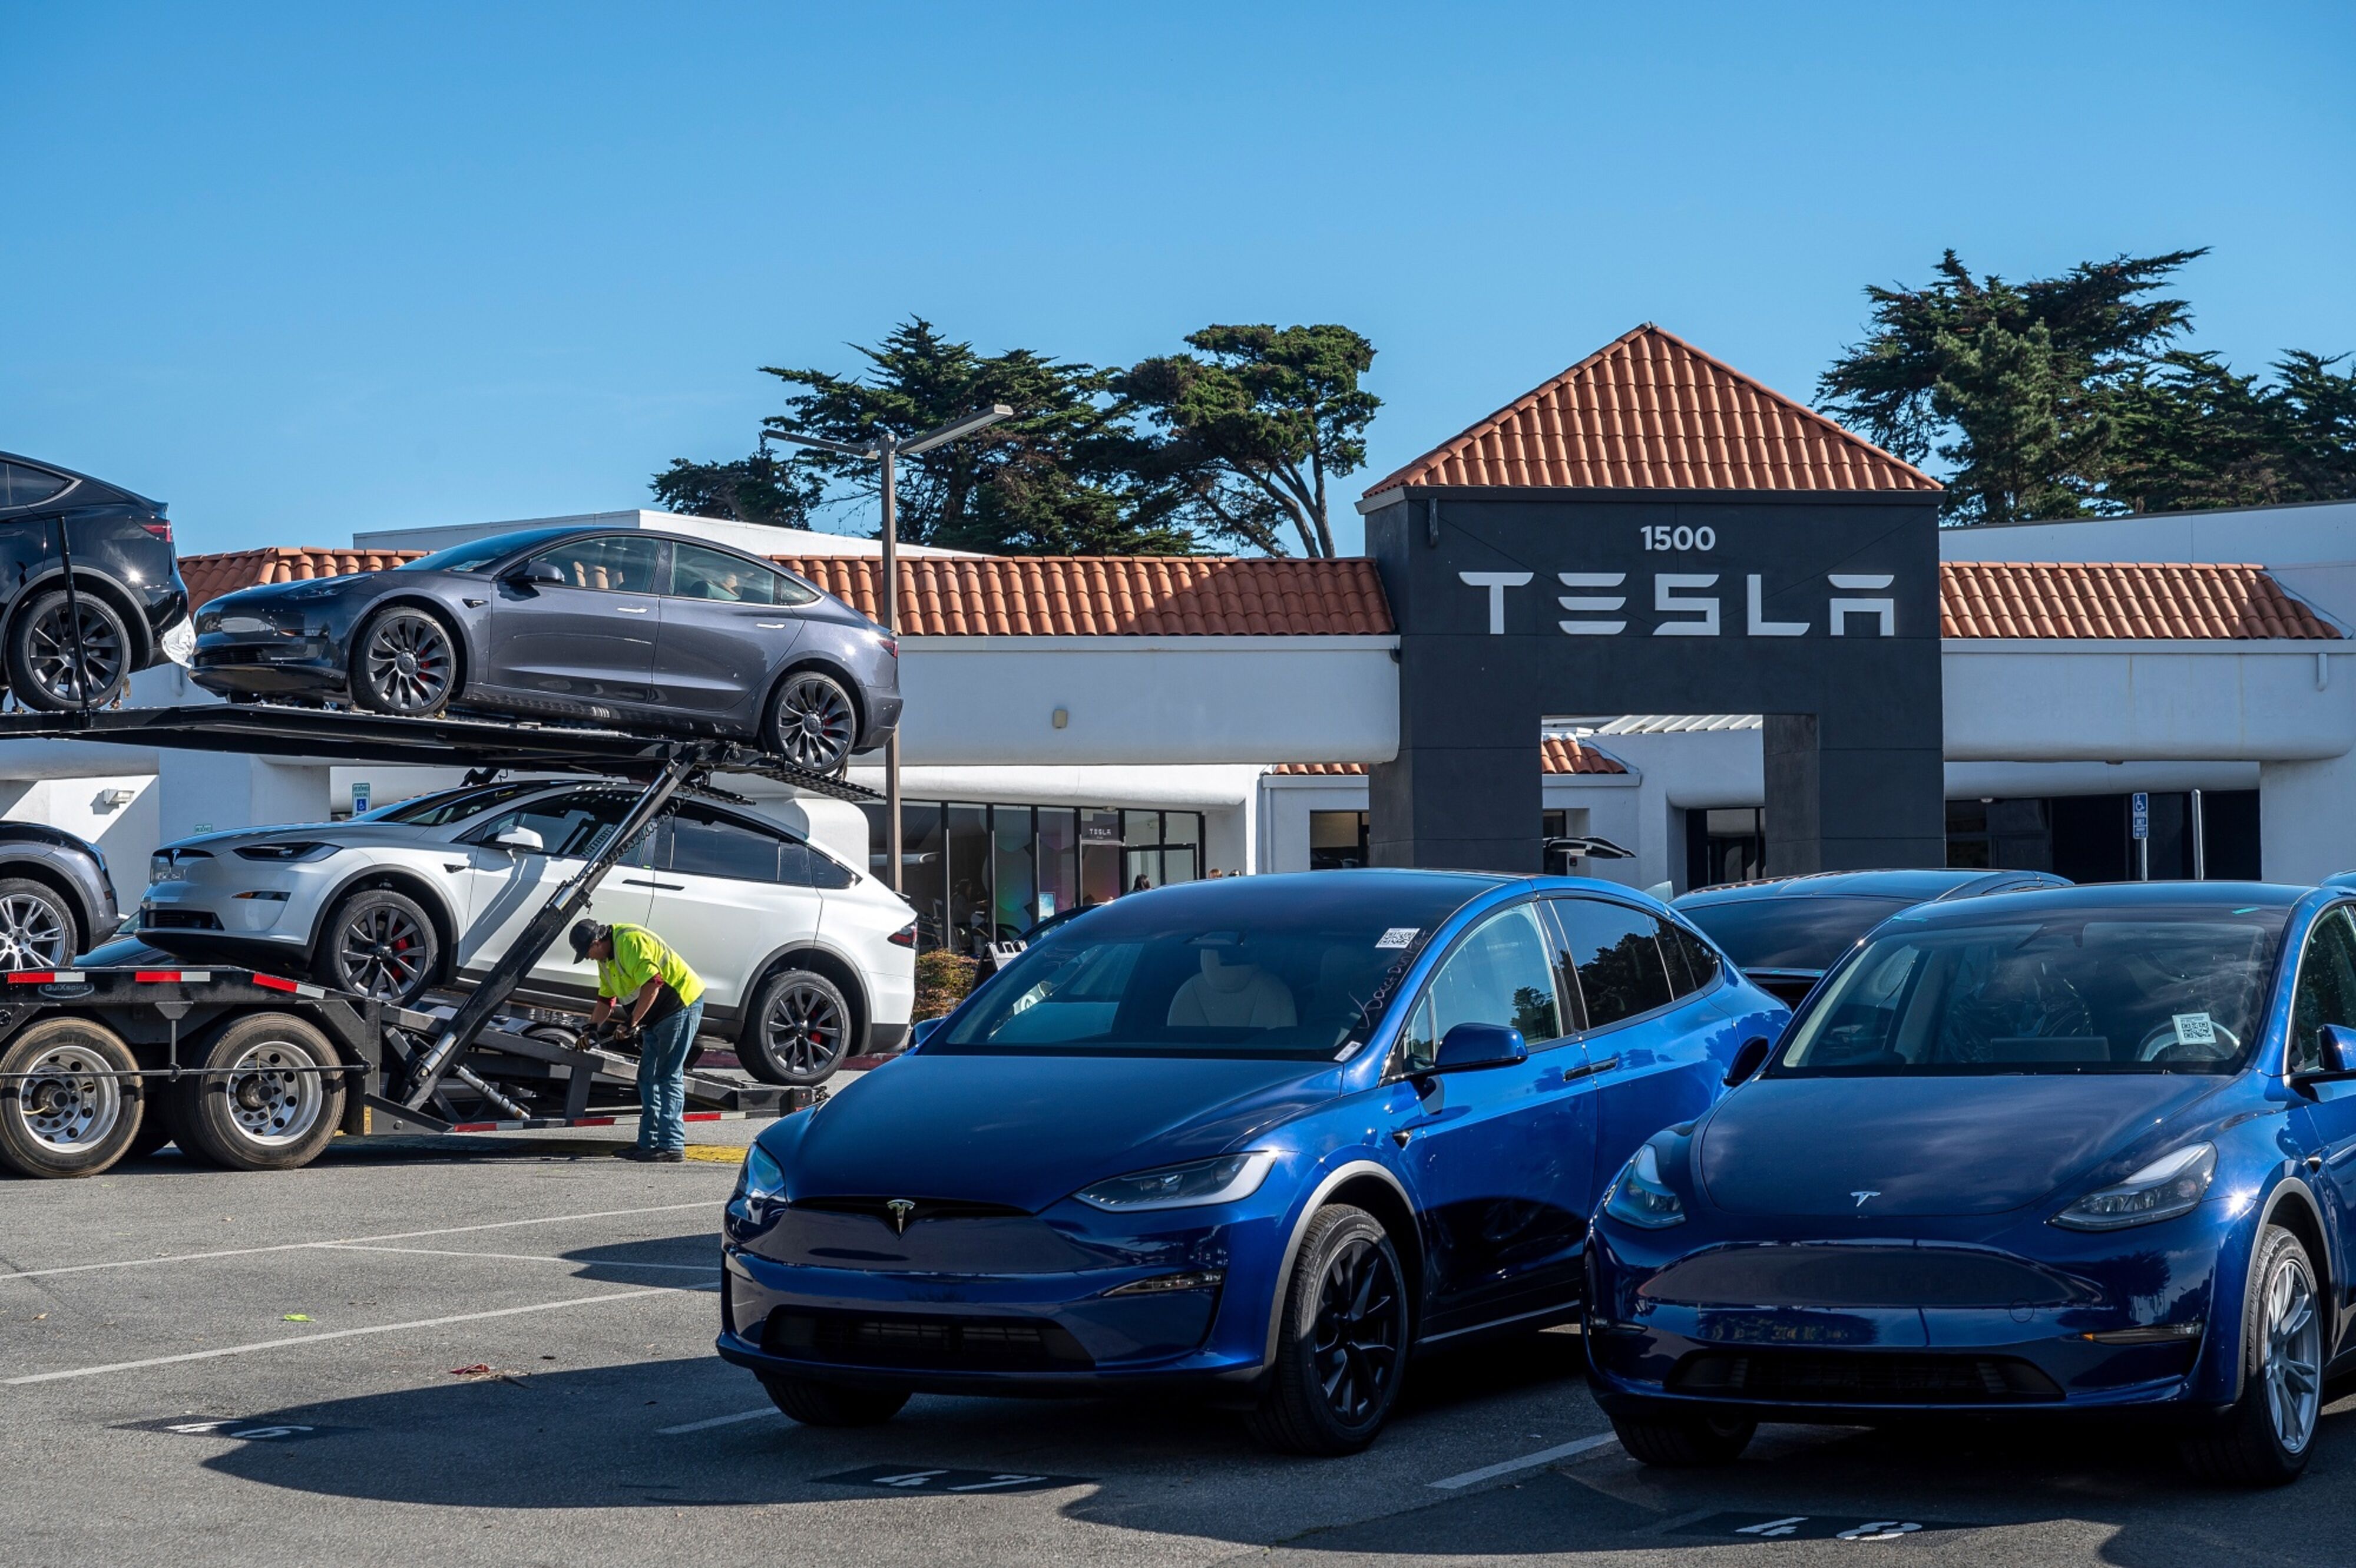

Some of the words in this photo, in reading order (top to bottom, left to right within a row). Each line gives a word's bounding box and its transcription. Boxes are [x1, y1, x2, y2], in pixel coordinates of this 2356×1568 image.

[1640, 525, 1716, 551] 1500
[1458, 571, 1895, 636] TESLA
[872, 1470, 1048, 1491] 47
[1735, 1517, 1922, 1540] 48
